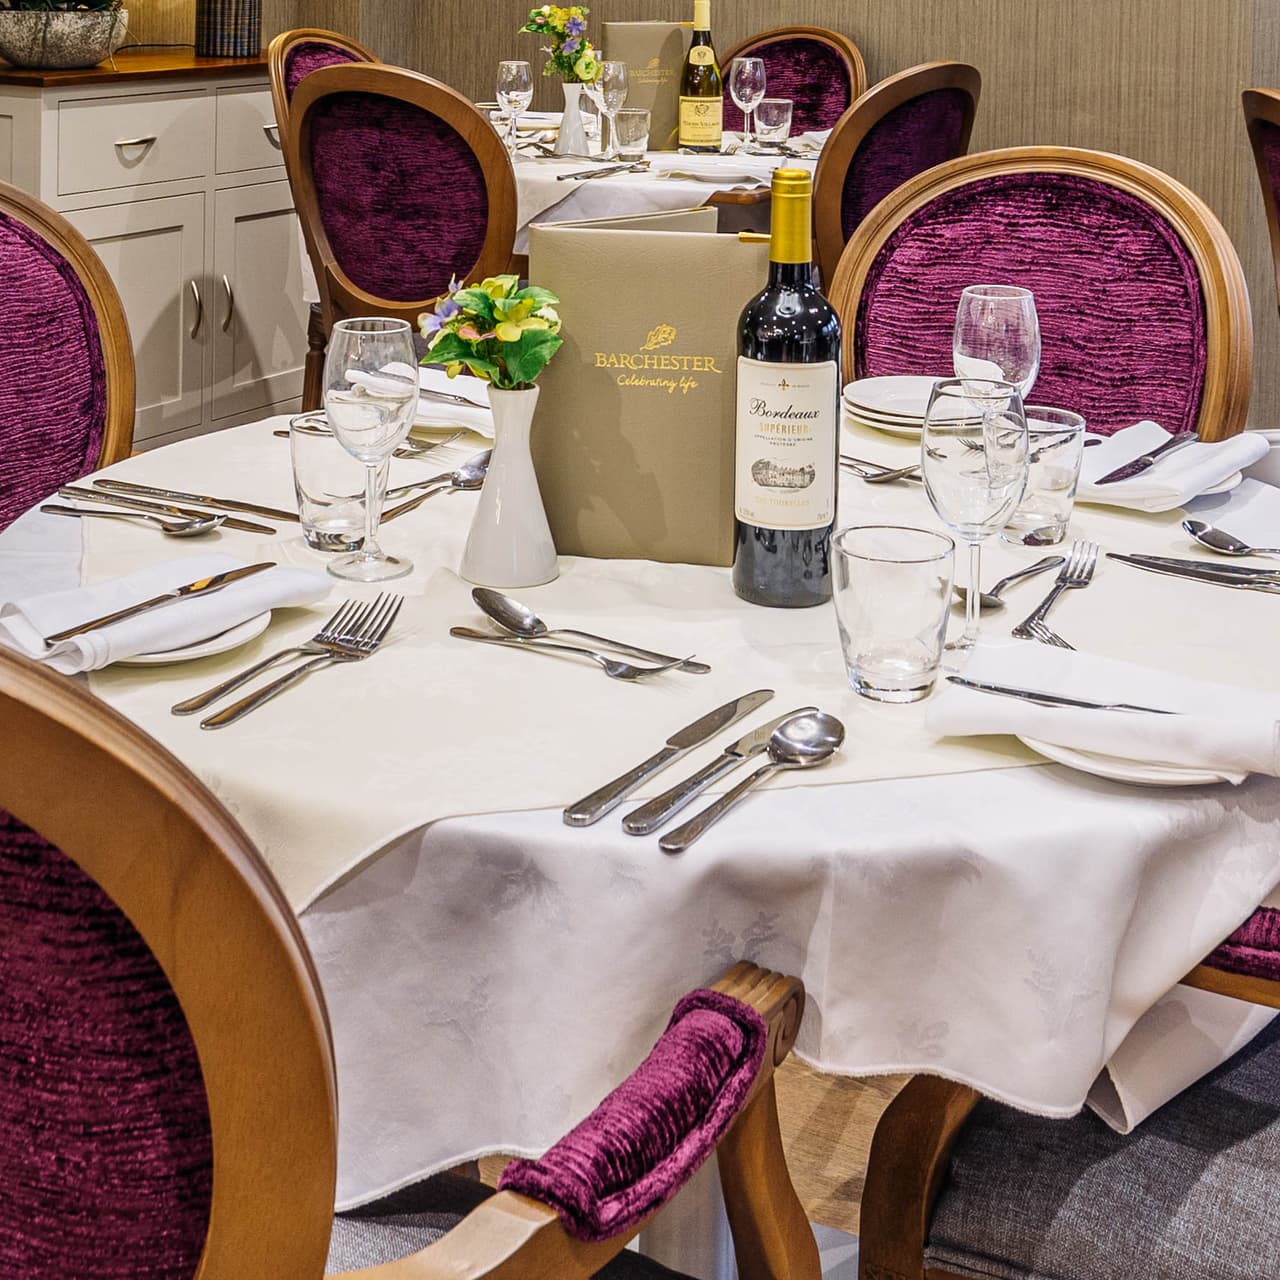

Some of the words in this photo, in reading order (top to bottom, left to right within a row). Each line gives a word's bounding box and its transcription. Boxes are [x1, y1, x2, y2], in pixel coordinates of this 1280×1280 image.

[594, 352, 723, 373] BARCHESTER
[617, 373, 678, 393] Celebrating
[679, 376, 699, 394] life
[749, 397, 820, 420] Bordeaux
